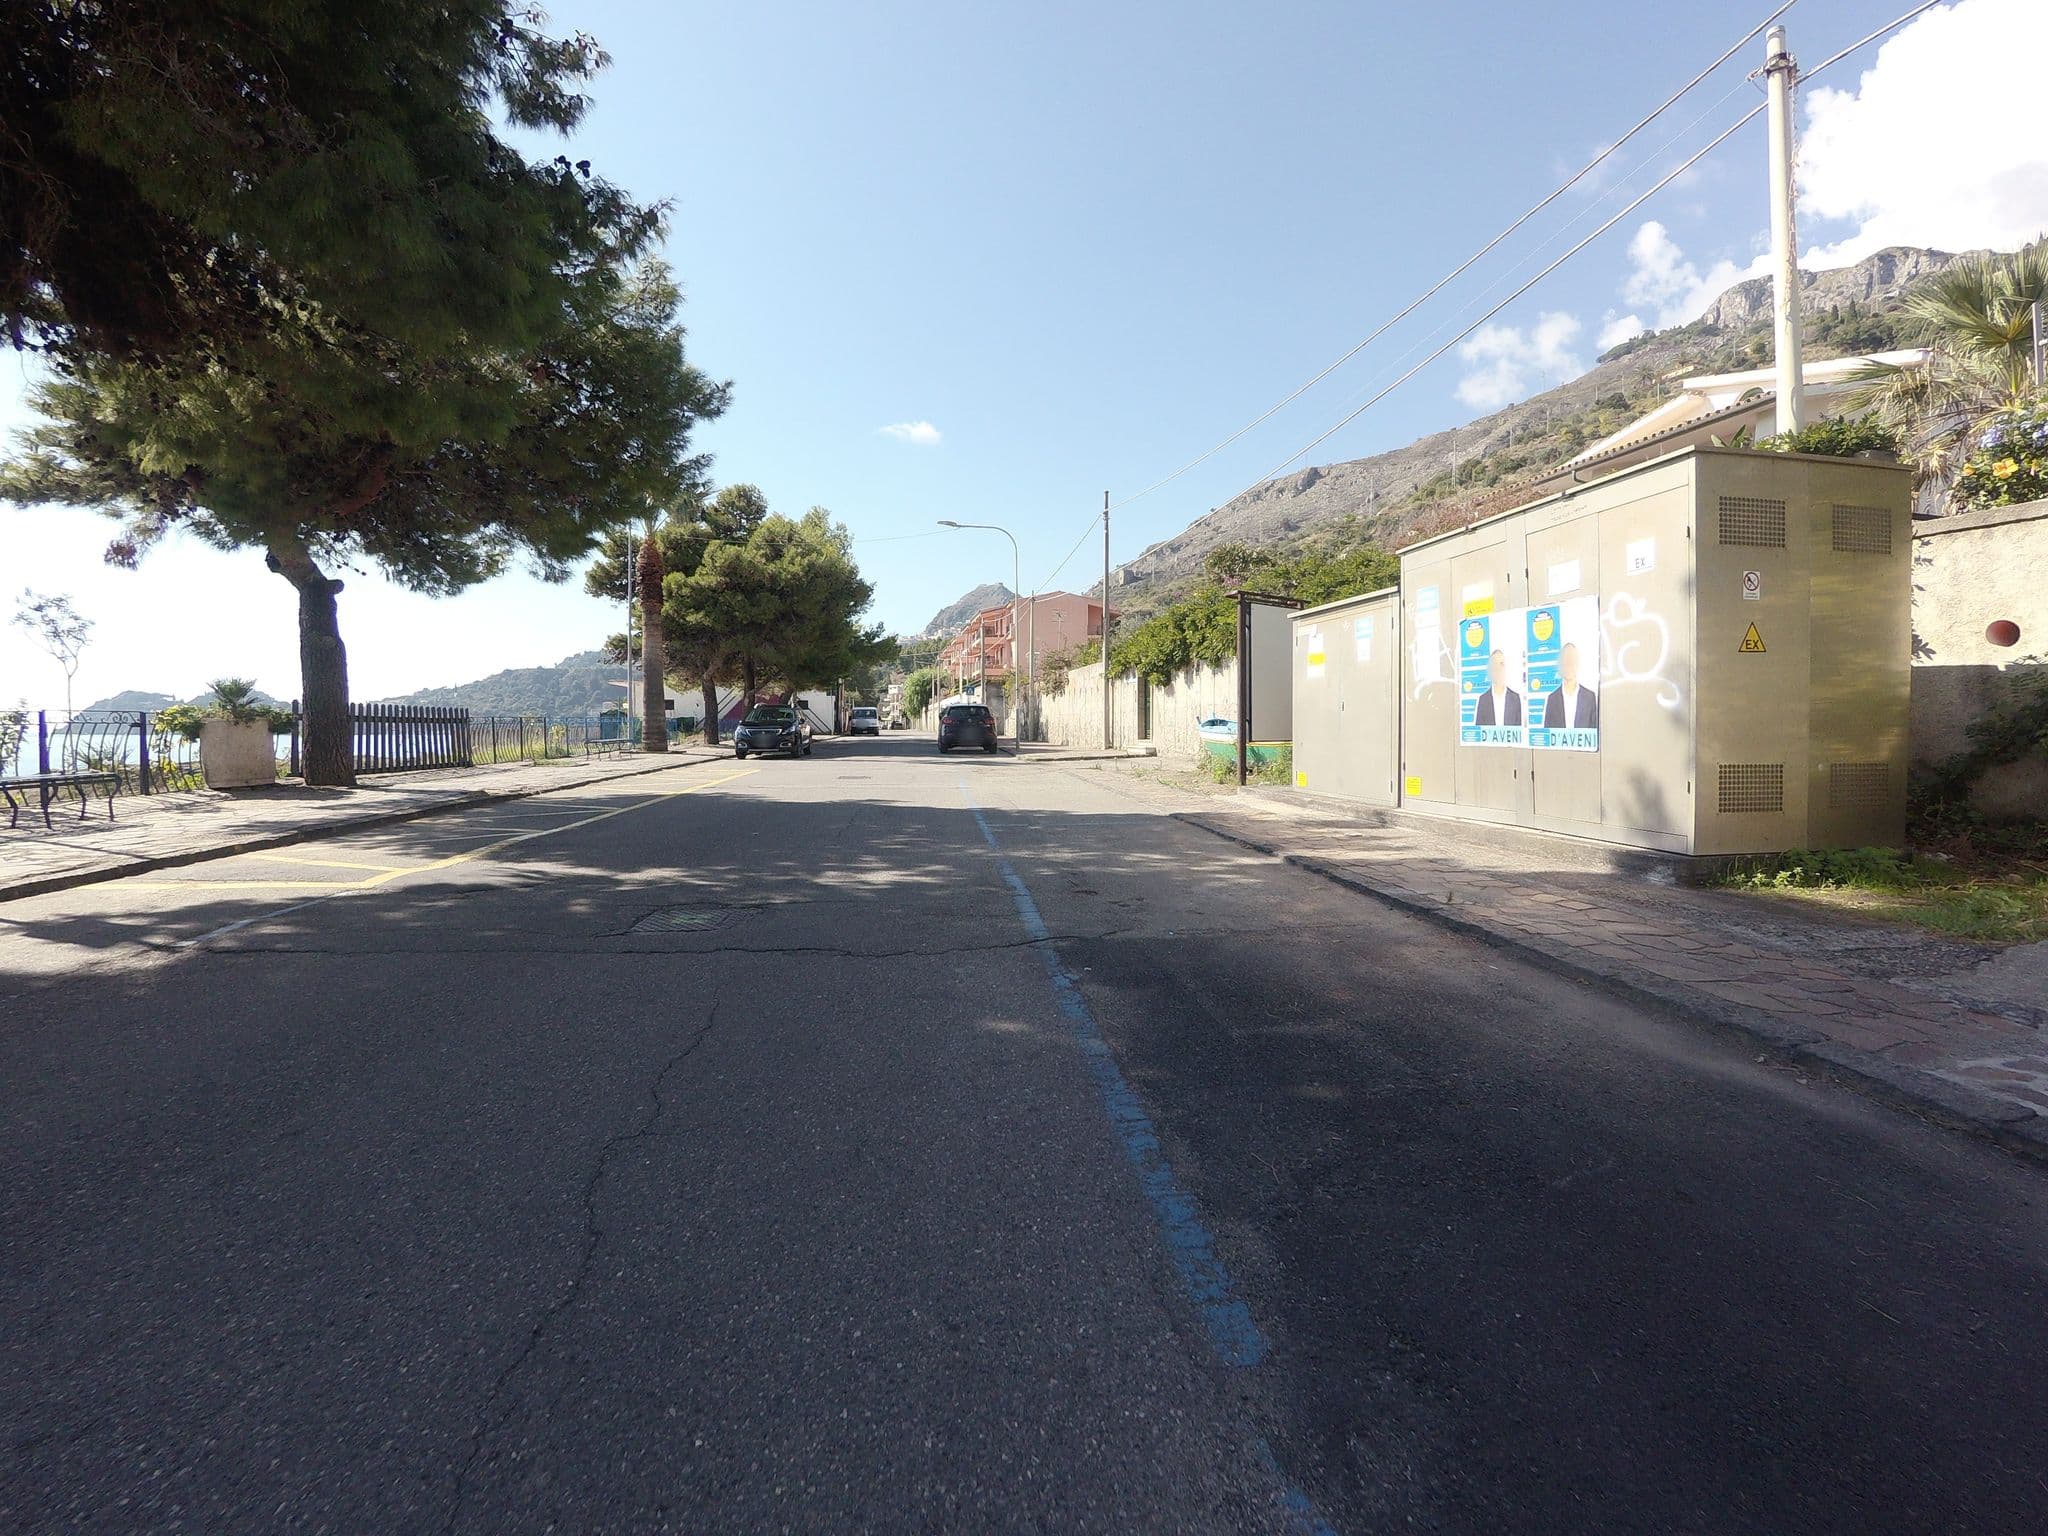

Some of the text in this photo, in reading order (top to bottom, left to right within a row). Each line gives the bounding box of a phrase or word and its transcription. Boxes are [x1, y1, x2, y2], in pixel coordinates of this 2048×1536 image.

[1745, 639, 1760, 650] EX
[1481, 730, 1522, 743] D'AVENI
[1550, 733, 1597, 747] D'AVENI
